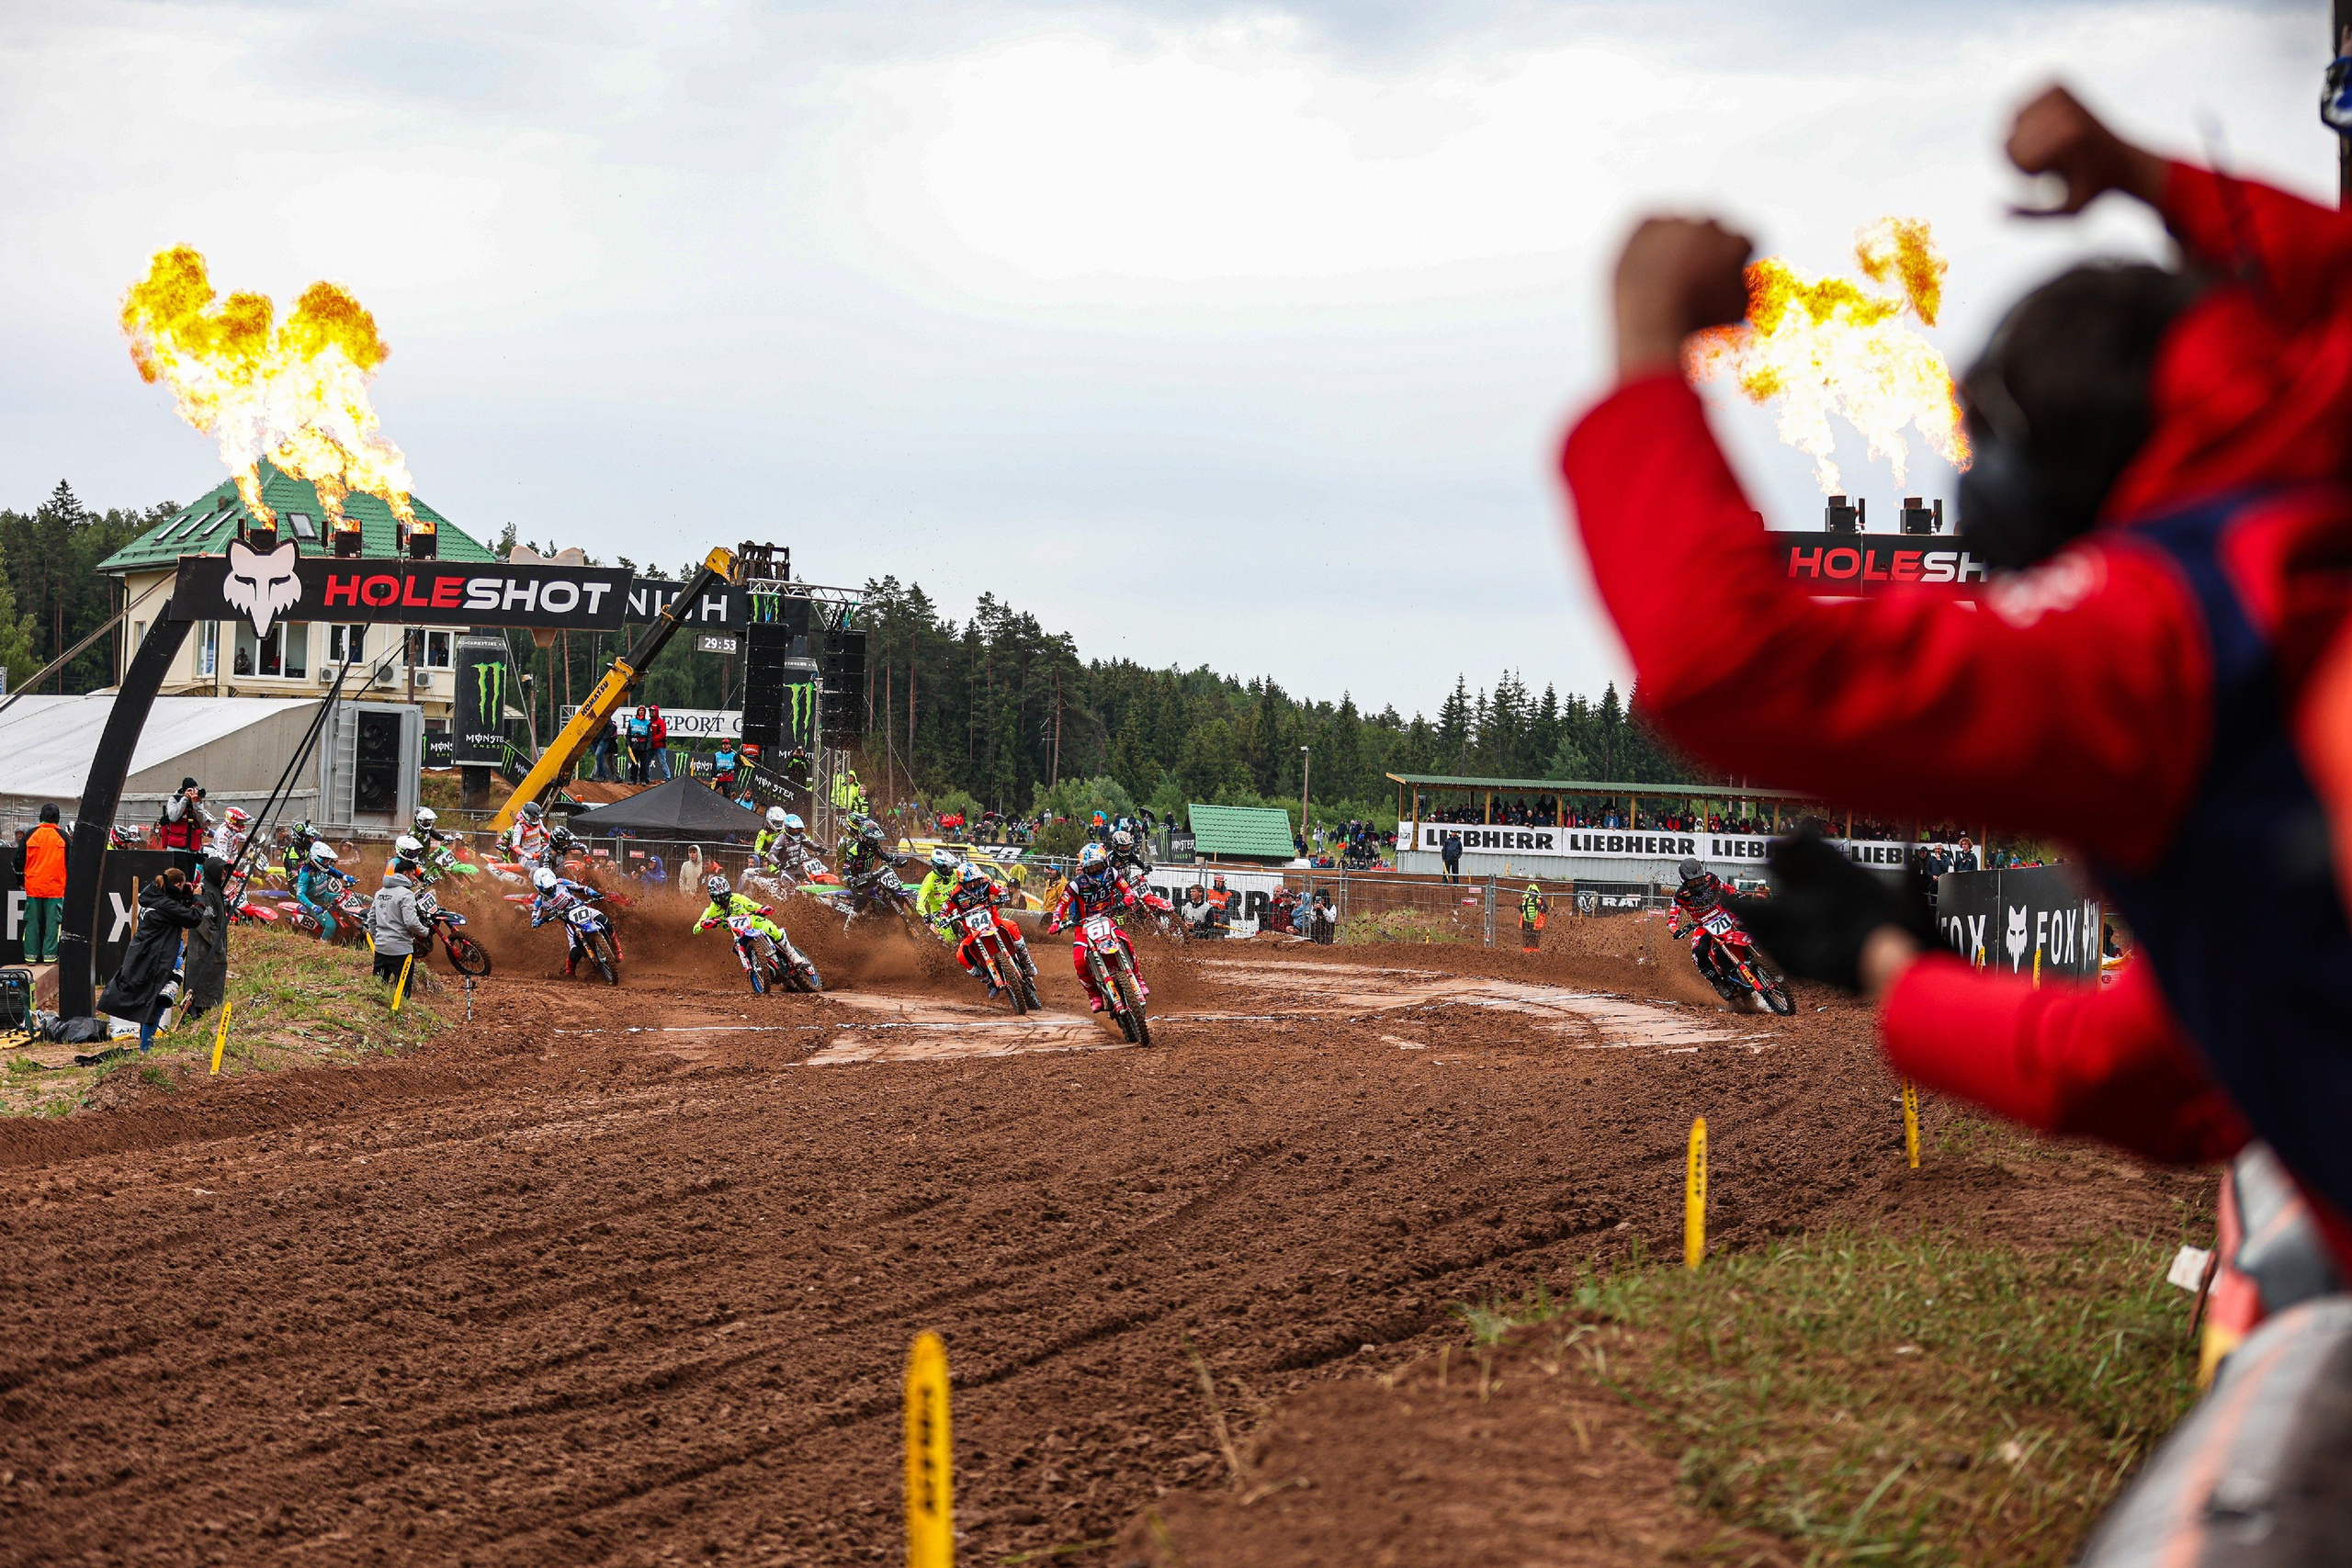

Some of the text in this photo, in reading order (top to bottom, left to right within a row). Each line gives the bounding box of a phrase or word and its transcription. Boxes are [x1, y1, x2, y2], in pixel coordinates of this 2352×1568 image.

[324, 574, 611, 614] HOLESHOT
[627, 589, 728, 622] NIH
[705, 637, 736, 650] 29:53
[581, 681, 609, 716] KOMATSU
[621, 714, 725, 733] FEPORT
[1171, 838, 1195, 852] MONSTER
[1426, 829, 1554, 850] LIBHERR
[1570, 834, 1695, 855] LIEBHERR
[807, 861, 822, 873] 142
[883, 873, 899, 888] 259
[300, 915, 317, 930] 189
[572, 909, 589, 922] 10
[732, 918, 747, 928] 77
[970, 914, 989, 929] 84
[1087, 919, 1110, 940] 61
[1712, 918, 1732, 935] 70
[2036, 908, 2076, 964] FOX
